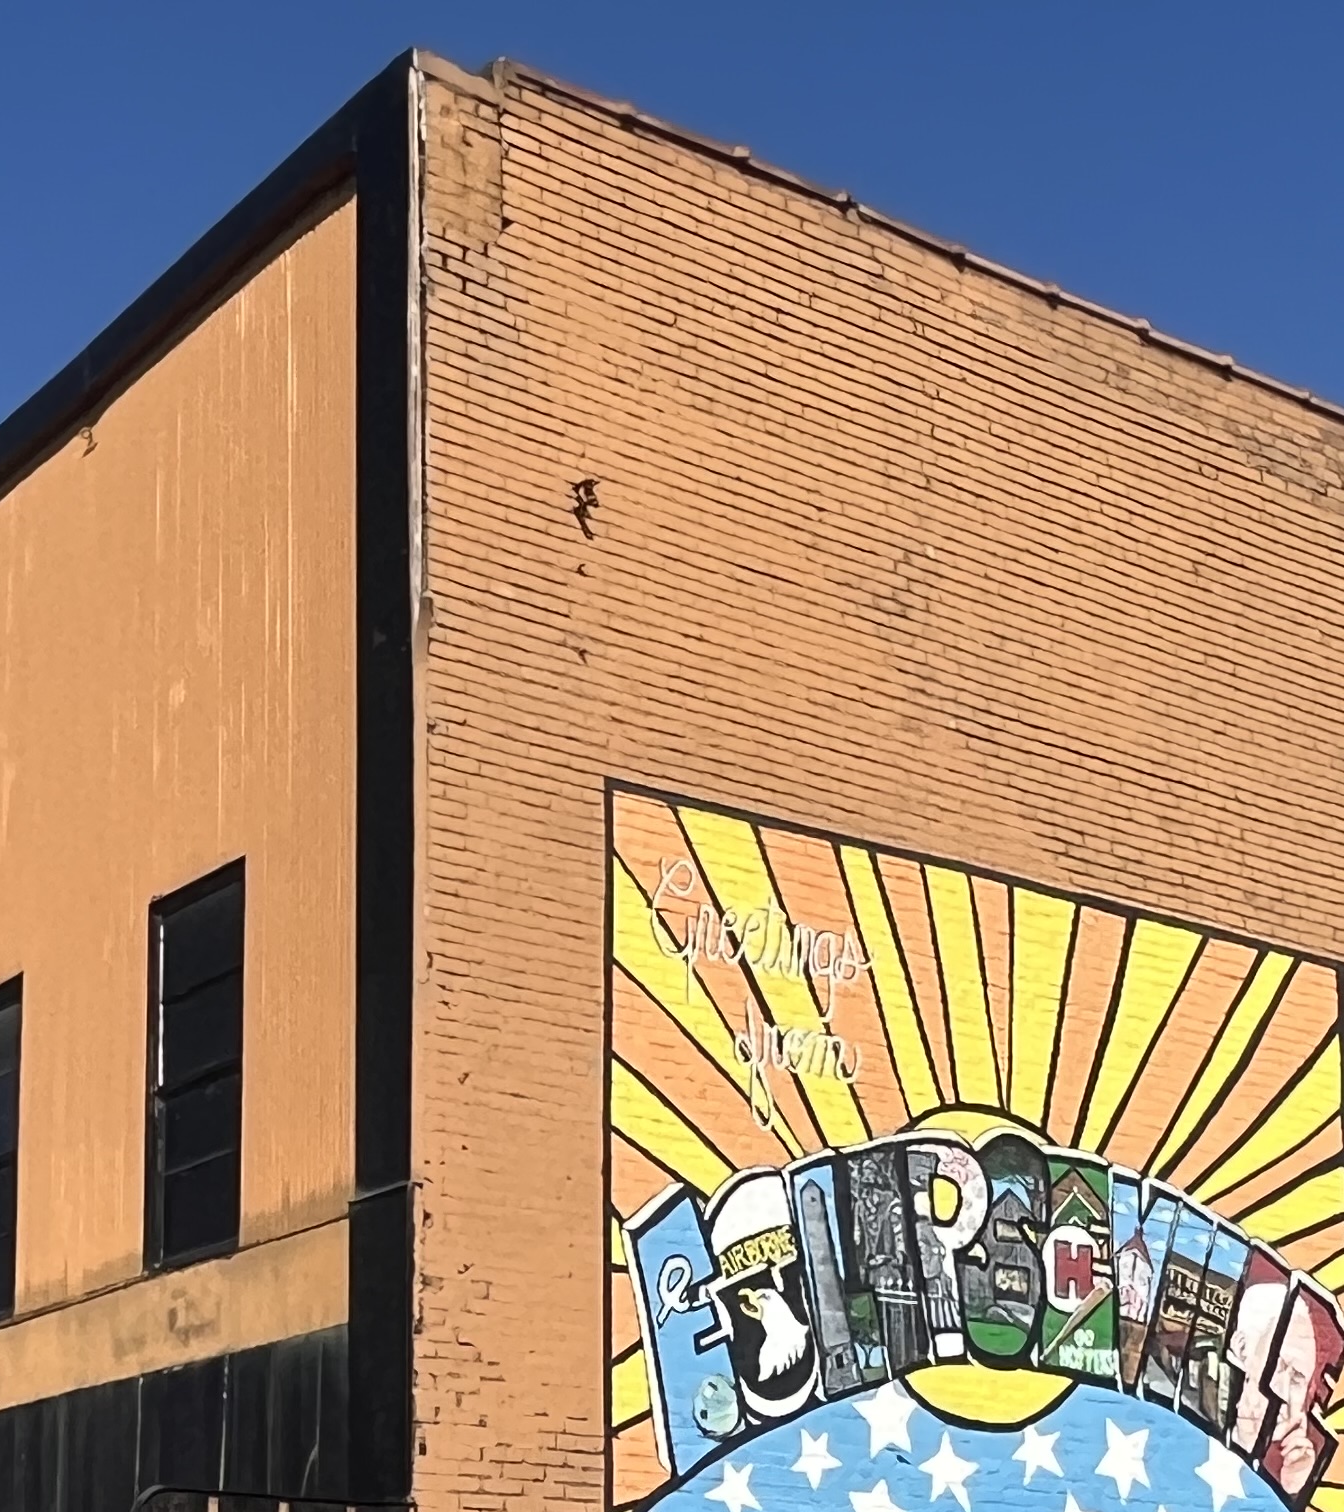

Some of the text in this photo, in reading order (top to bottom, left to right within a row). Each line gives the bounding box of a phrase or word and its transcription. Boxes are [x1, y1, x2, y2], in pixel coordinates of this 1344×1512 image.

[651, 856, 874, 1022] Greetings
[734, 994, 861, 1130] from
[718, 1225, 796, 1280] AIRBORNE
